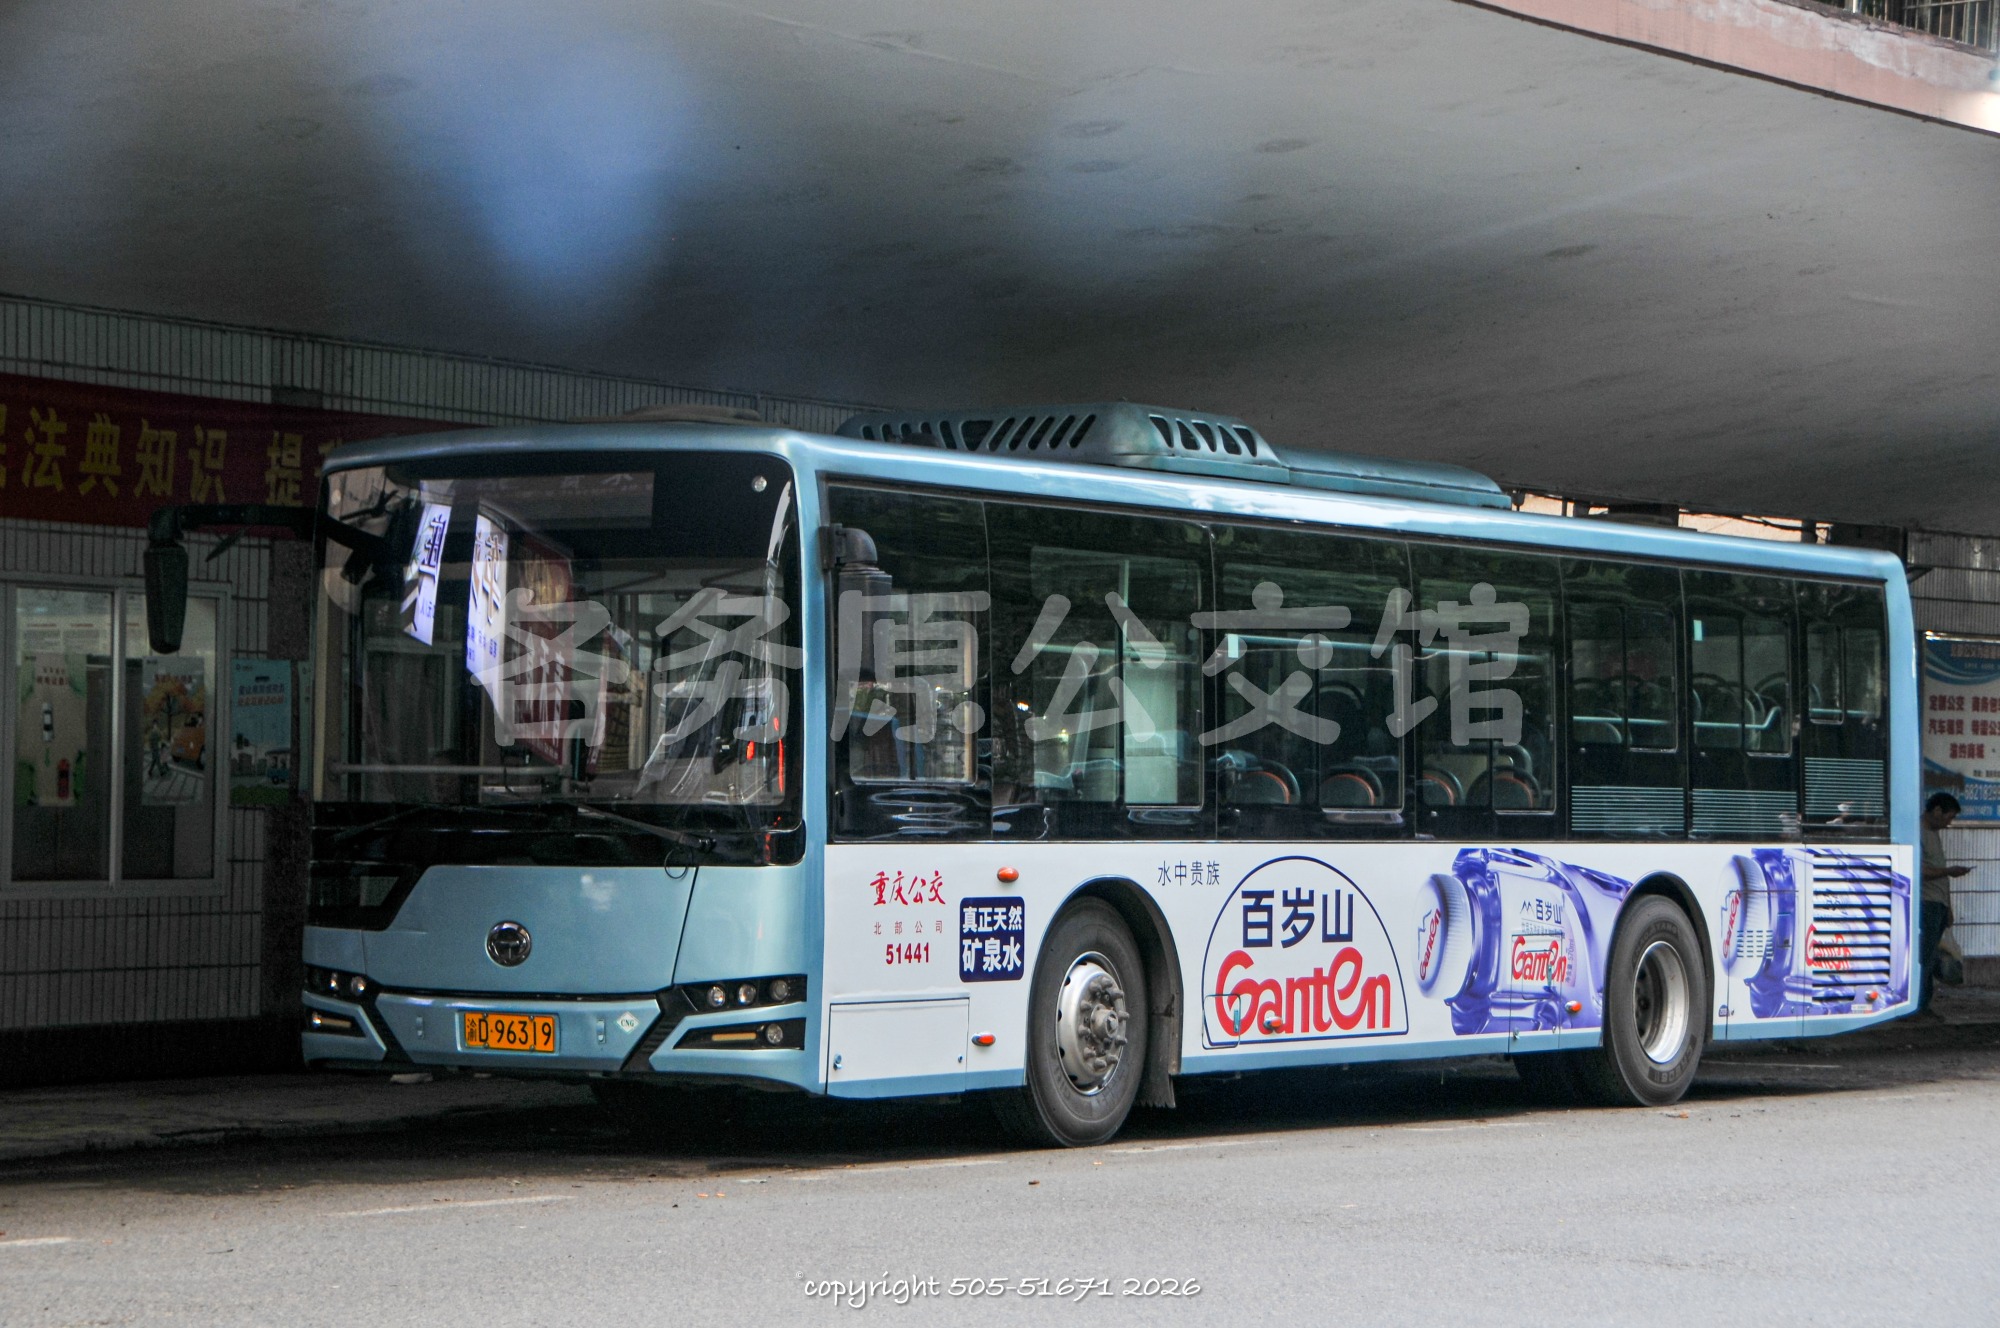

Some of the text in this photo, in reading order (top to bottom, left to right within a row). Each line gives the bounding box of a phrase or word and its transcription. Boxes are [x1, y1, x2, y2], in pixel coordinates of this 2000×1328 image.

[1157, 860, 1220, 886] 水中贵族
[870, 870, 946, 906] 重庆公交
[962, 905, 1023, 933] 真正天然
[1241, 887, 1354, 949] 百岁山
[886, 942, 930, 965] 51441
[962, 936, 1022, 973] 矿泉水
[620, 1019, 635, 1028] CNG
